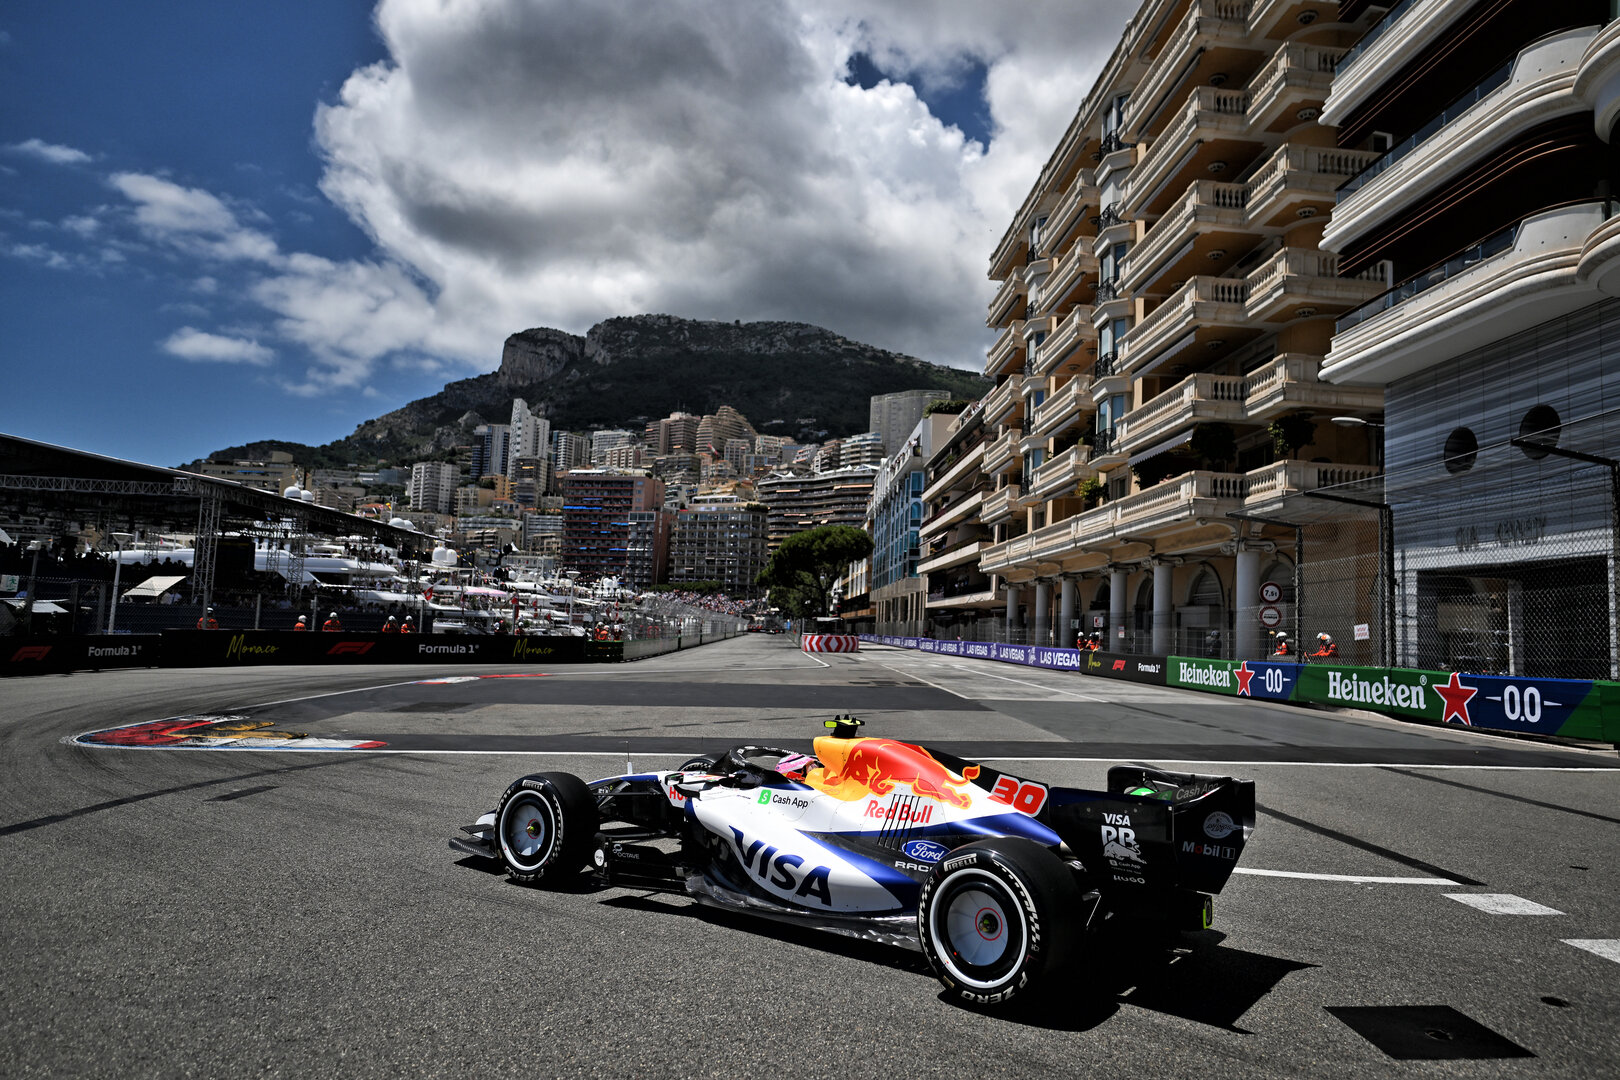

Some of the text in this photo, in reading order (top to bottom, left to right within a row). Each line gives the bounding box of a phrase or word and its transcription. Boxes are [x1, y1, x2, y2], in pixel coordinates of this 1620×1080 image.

[88, 647, 129, 656] Formula
[227, 634, 279, 660] Monaco
[419, 644, 466, 653] Formula
[514, 638, 554, 660] Monaco
[966, 645, 987, 656] LAS VEGAS
[1000, 647, 1008, 658] LAS
[1008, 648, 1024, 661] VEGAS
[1040, 651, 1052, 663] LAS
[1138, 662, 1155, 673] Formula
[1179, 662, 1230, 687] Heineken
[1328, 671, 1426, 709] Heineken
[773, 794, 808, 808] Cash App
[987, 775, 1048, 817] 30
[1176, 786, 1200, 800] Cash
[864, 800, 933, 823] Red Bull
[1102, 812, 1131, 826] VISA
[911, 843, 944, 861] Ford
[1182, 841, 1220, 857] Mobil
[729, 825, 832, 906] VISA
[943, 853, 977, 872] PIRELLI
[961, 971, 1028, 1004] P ZERO
